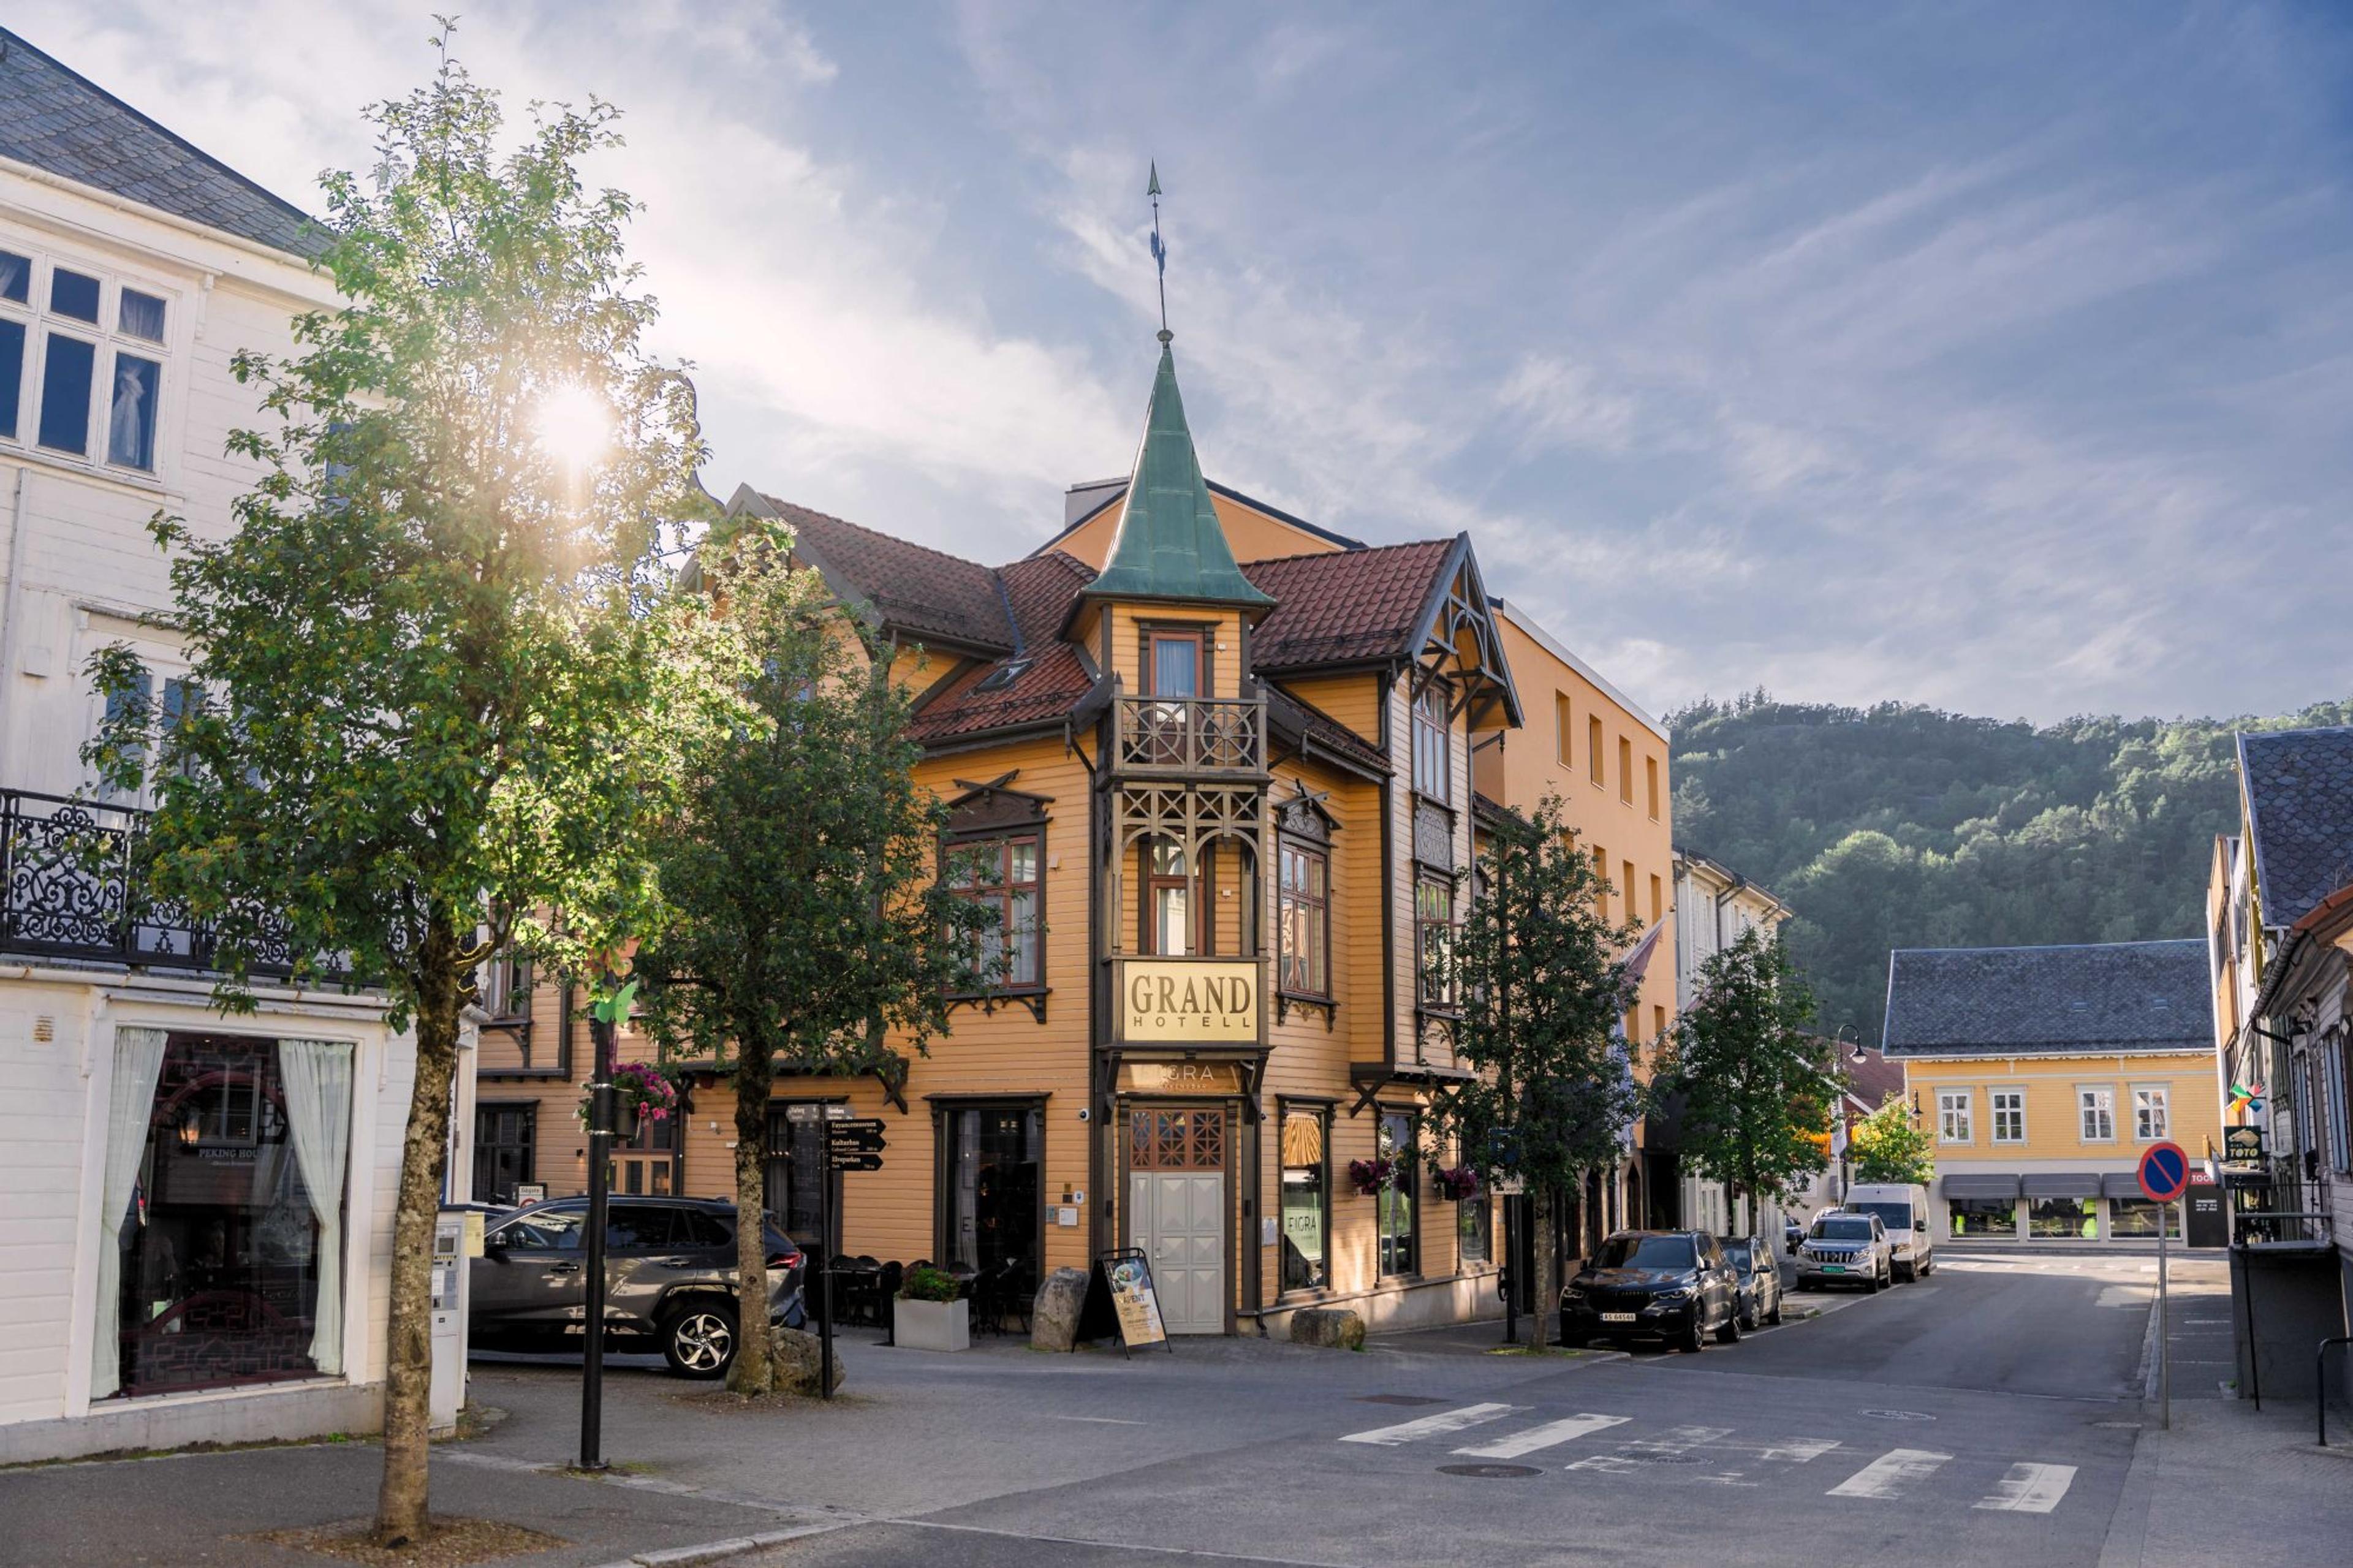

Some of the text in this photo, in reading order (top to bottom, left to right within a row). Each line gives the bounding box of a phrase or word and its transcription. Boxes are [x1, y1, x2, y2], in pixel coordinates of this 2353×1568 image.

[1131, 974, 1251, 1015] GRAND
[1134, 1016, 1251, 1028] HOTELL
[199, 1148, 237, 1157] PEKING
[2230, 1148, 2258, 1157] TOTO
[1289, 1216, 1316, 1232] EIGRA
